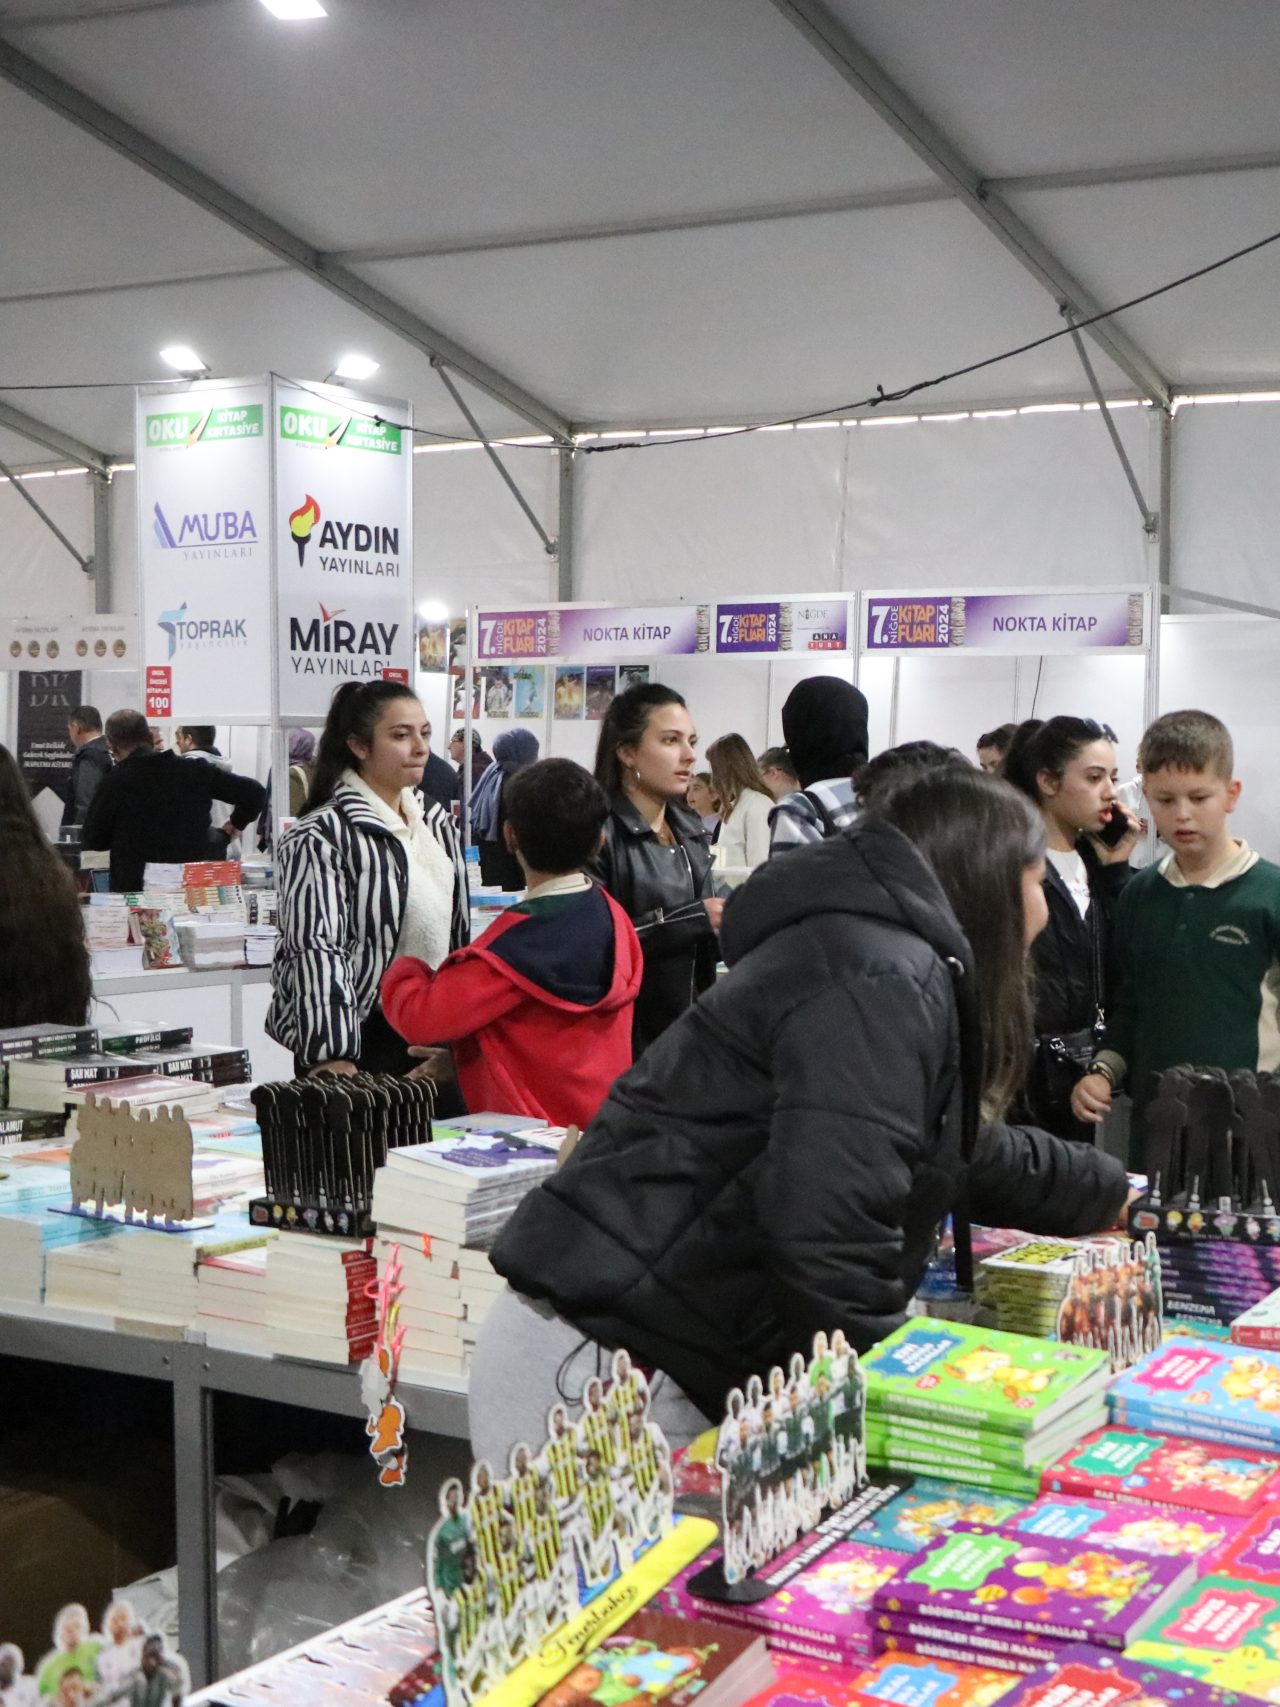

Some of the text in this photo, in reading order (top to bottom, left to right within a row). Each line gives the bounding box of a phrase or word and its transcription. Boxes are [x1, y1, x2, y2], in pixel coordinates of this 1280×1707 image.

[150, 416, 189, 440] OKU
[284, 414, 328, 438] OKU
[179, 510, 257, 543] MUBA
[319, 520, 399, 555] AYDIN
[183, 548, 253, 561] YAYINLARI
[320, 556, 400, 578] YAYINLARI
[739, 613, 766, 627] KİTAP
[899, 604, 935, 624] KİTAP
[993, 613, 1097, 632] NOKTA KİTAP
[176, 618, 247, 640] TOPRAK
[503, 617, 534, 635] KİTAP
[583, 623, 672, 642] NOKTA KİTAP
[768, 613, 777, 642] 2024
[899, 624, 935, 643] FUARI
[939, 605, 949, 643] 2024
[503, 635, 535, 653] FUARI
[537, 618, 546, 652] 2024
[739, 627, 766, 642] FUARI
[149, 697, 168, 708] 100
[84, 1068, 98, 1078] MAT
[180, 1059, 193, 1070] MAT
[1166, 1299, 1216, 1316] BENZEMA
[1023, 1620, 1088, 1640] MASALLAR
